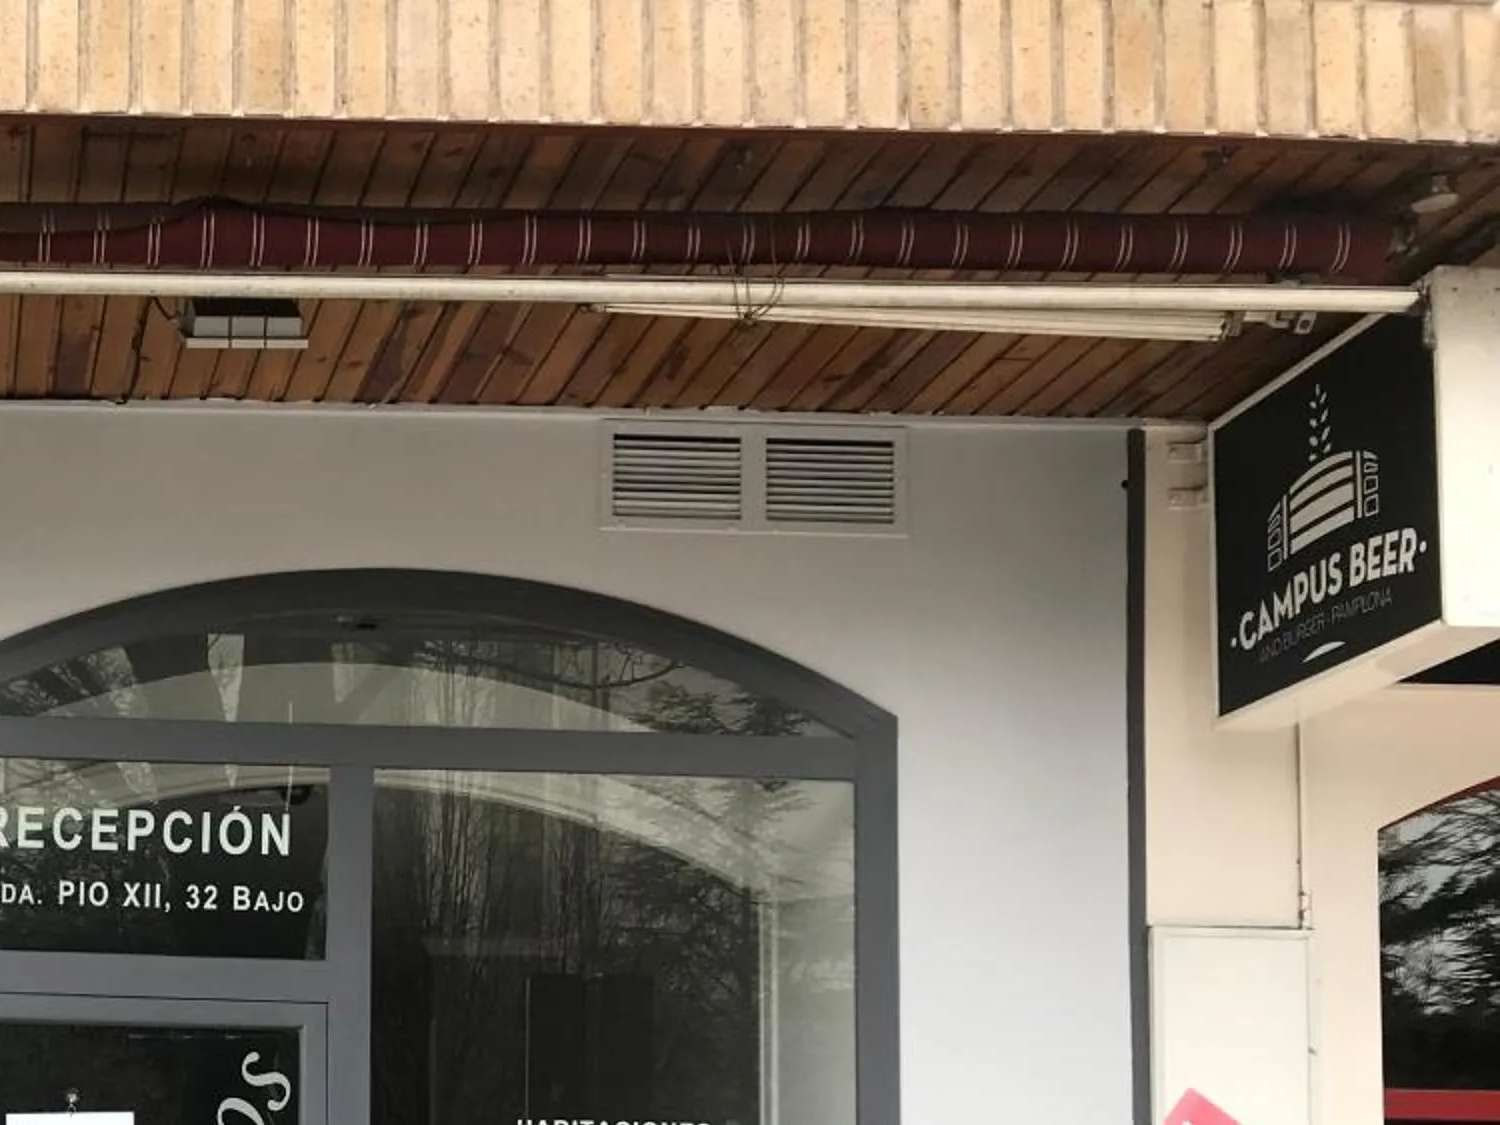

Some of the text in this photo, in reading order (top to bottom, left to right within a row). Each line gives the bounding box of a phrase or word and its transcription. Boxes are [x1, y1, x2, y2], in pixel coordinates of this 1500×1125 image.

[1239, 527, 1418, 651] CAMPUS BEER
[59, 880, 109, 907] PIO
[122, 882, 170, 913] XII,
[185, 886, 219, 909] 32
[232, 886, 304, 912] BAJO
